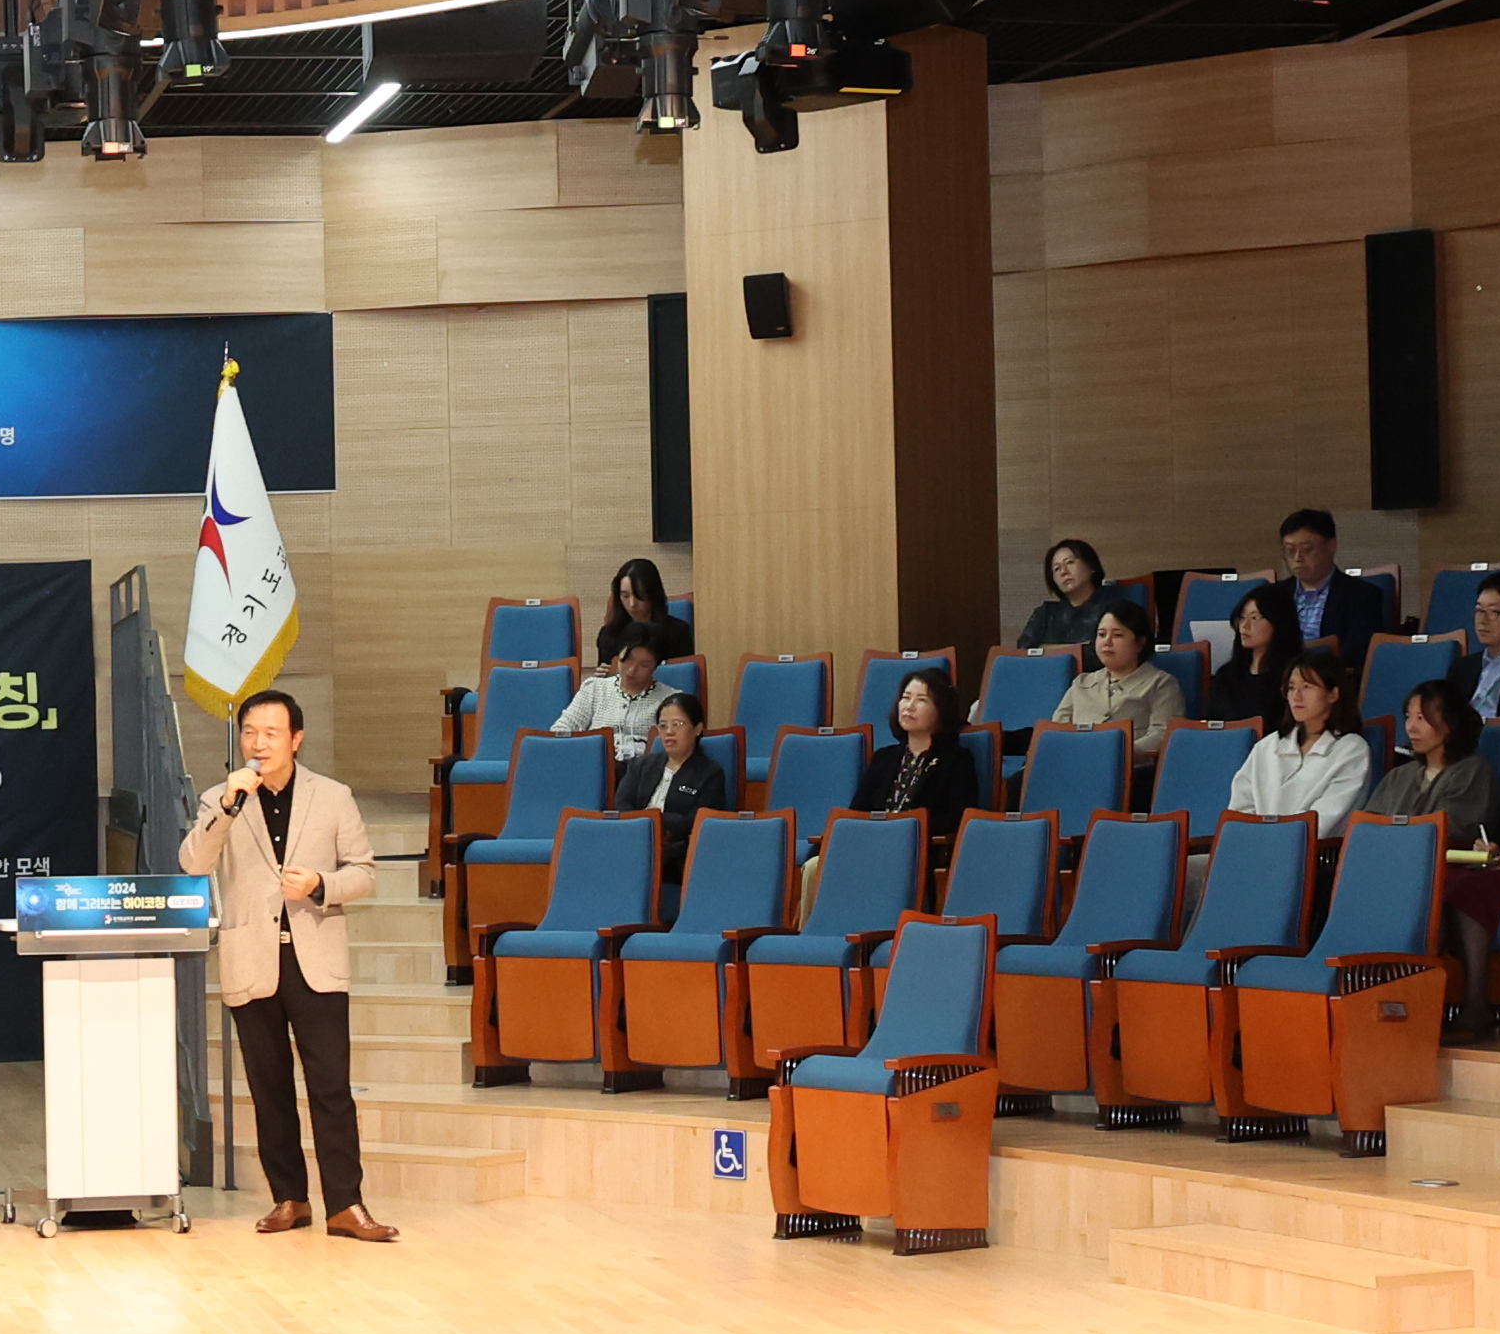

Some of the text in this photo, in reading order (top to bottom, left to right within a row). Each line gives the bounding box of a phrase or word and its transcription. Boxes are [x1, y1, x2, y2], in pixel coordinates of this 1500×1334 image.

[15, 856, 51, 877] 모색
[107, 882, 137, 895] 2024
[79, 897, 122, 911] 그려보는
[122, 896, 166, 910] 하이코칭
